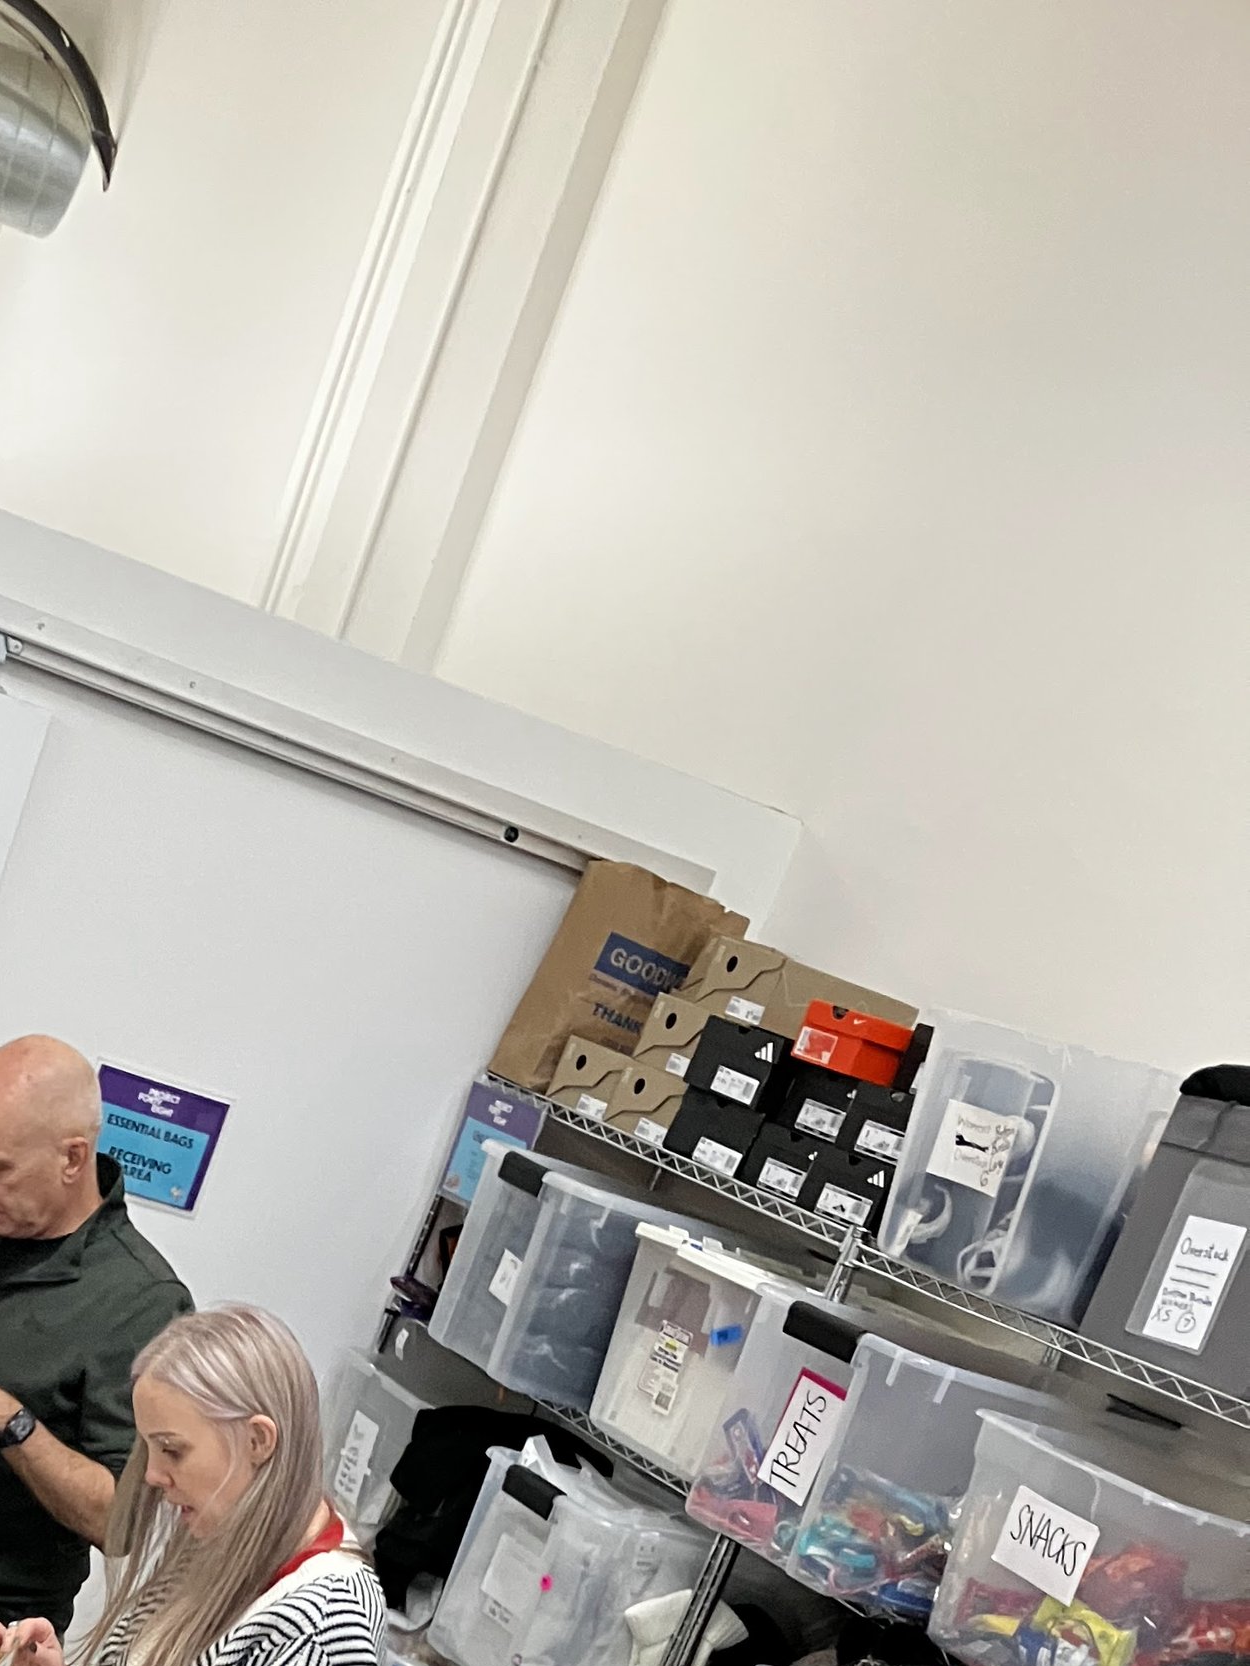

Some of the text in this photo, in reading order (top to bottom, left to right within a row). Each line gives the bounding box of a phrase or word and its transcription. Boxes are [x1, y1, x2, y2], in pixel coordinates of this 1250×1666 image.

[107, 1113, 194, 1149] ESSENTIAL BAGS
[109, 1146, 172, 1175] RECEIVING
[123, 1164, 151, 1182] AREA
[769, 1389, 827, 1488] TREATS
[1009, 1503, 1087, 1577] SNACKS
